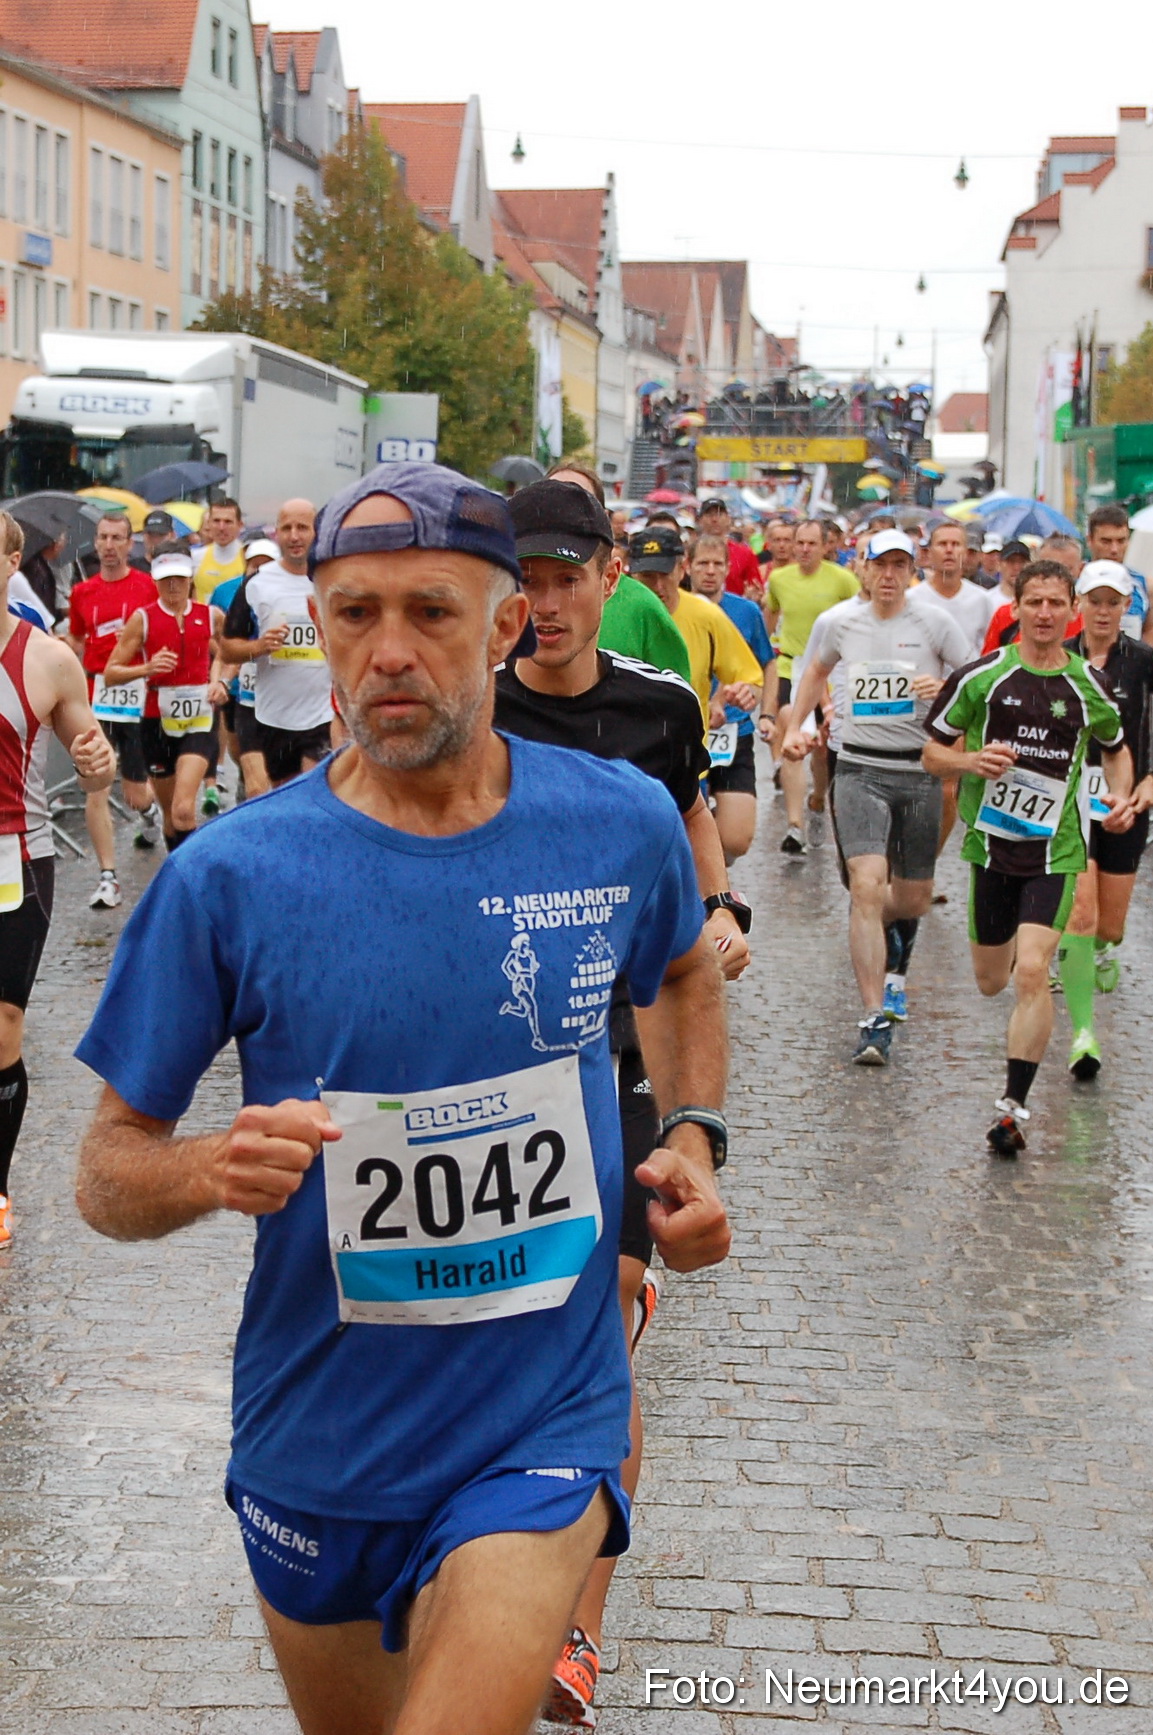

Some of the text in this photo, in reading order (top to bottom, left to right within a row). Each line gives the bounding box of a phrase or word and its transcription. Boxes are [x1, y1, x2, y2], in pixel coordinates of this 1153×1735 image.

[59, 394, 151, 416] BOCK
[752, 443, 808, 457] START
[100, 688, 140, 705] 2135
[855, 677, 908, 700] 2212
[171, 699, 202, 718] 207
[1017, 724, 1049, 741] DAV
[991, 738, 1070, 760] henbach
[991, 781, 1056, 821] 3147
[478, 885, 631, 915] 12. NEUMARKTER
[512, 905, 613, 932] STADTLAUF
[405, 1092, 508, 1131] BOCK
[355, 1129, 571, 1241] 2042
[341, 1233, 353, 1249] A
[415, 1244, 527, 1290] Harald
[242, 1495, 320, 1558] SIEMENS
